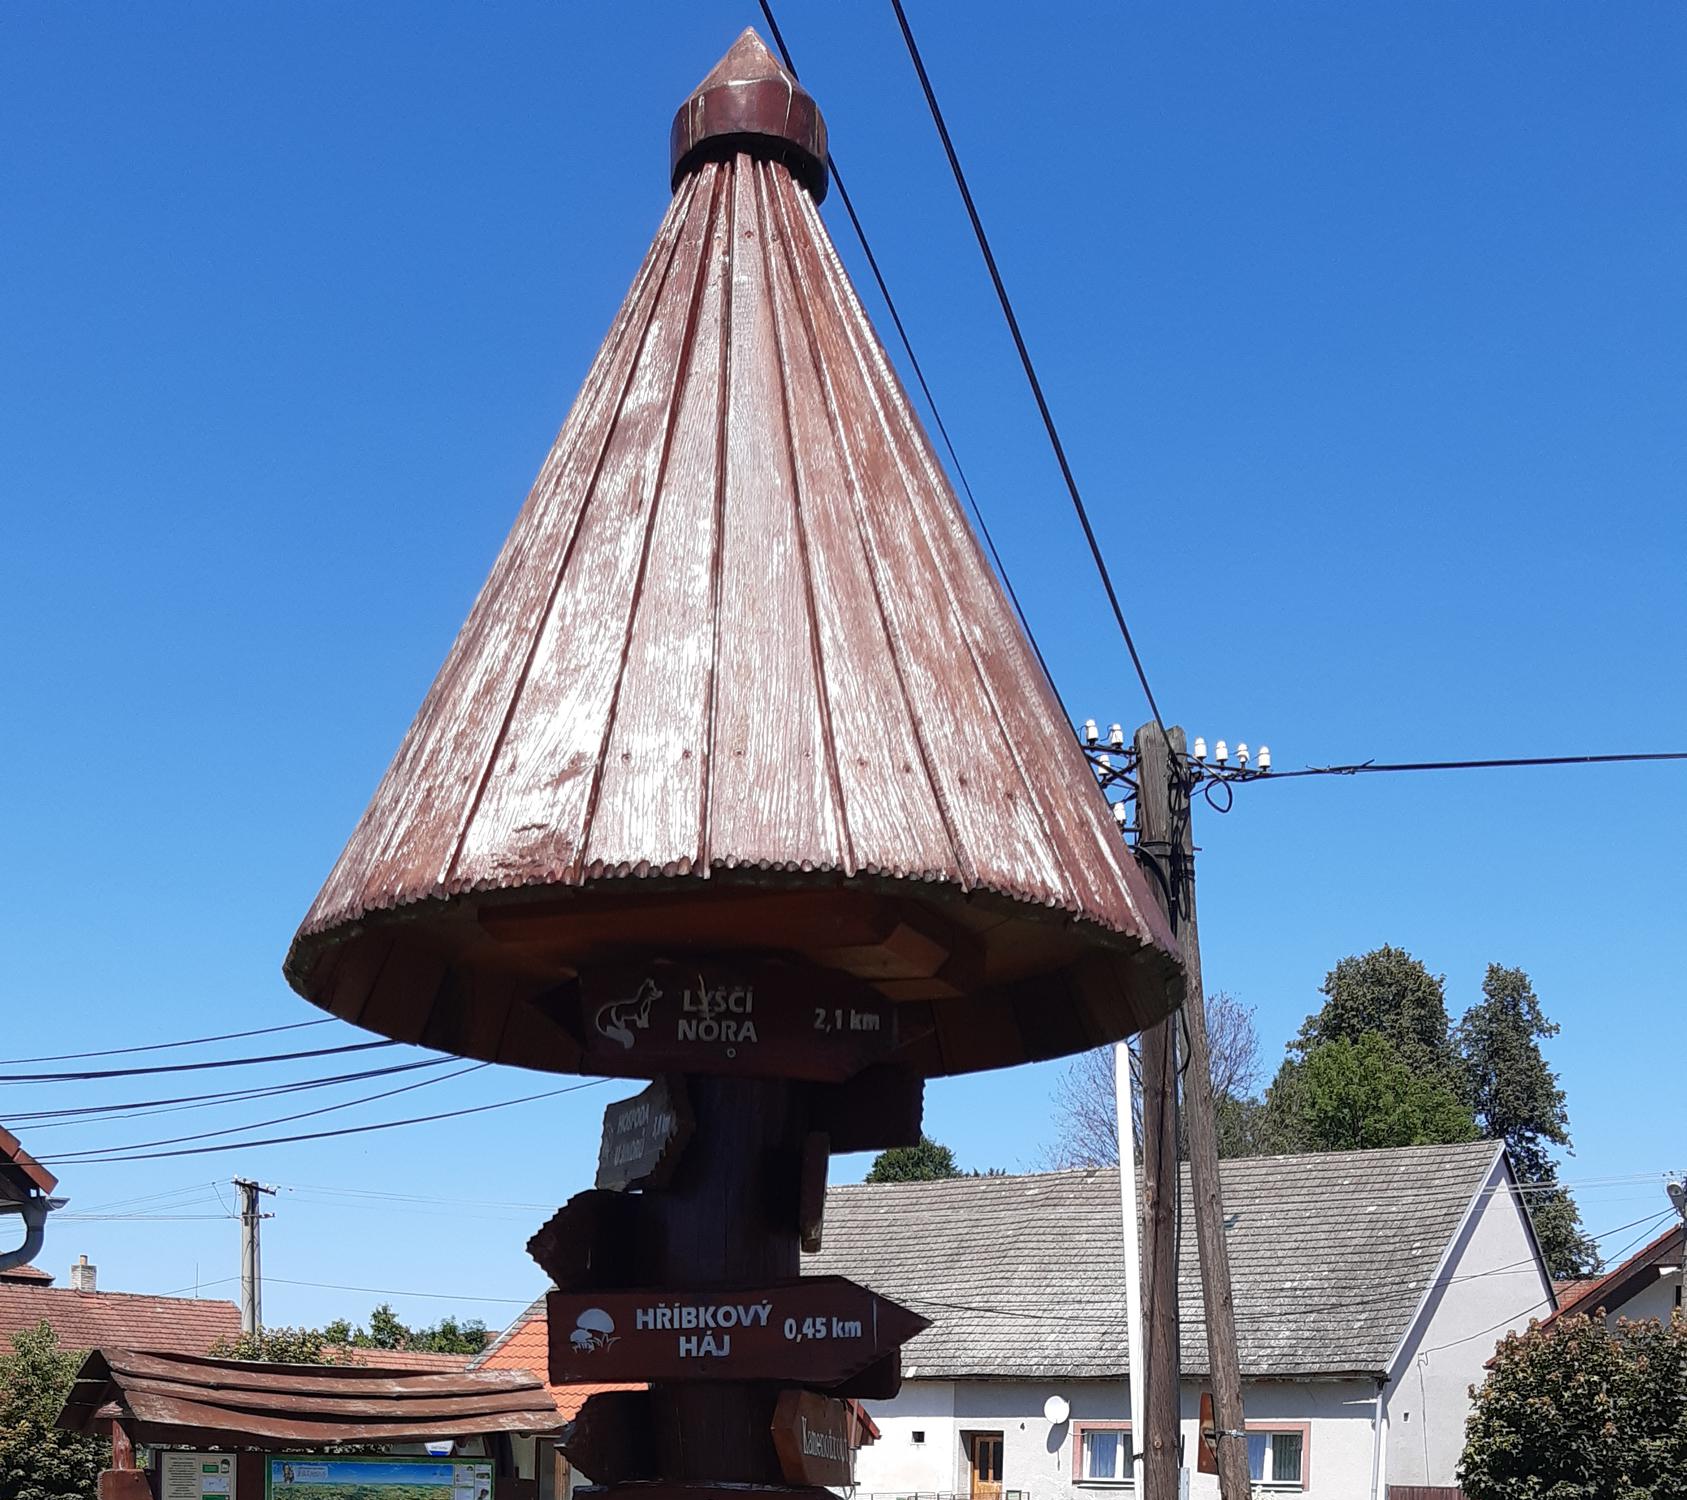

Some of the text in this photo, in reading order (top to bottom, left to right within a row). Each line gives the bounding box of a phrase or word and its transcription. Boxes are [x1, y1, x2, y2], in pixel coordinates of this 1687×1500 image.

[677, 1019, 759, 1043] NORA
[814, 1008, 880, 1033] 2,1 km
[636, 1300, 773, 1330] HŘÍBKOVÝ
[784, 1317, 862, 1343] 0,45 km
[679, 1330, 731, 1358] HÁJ
